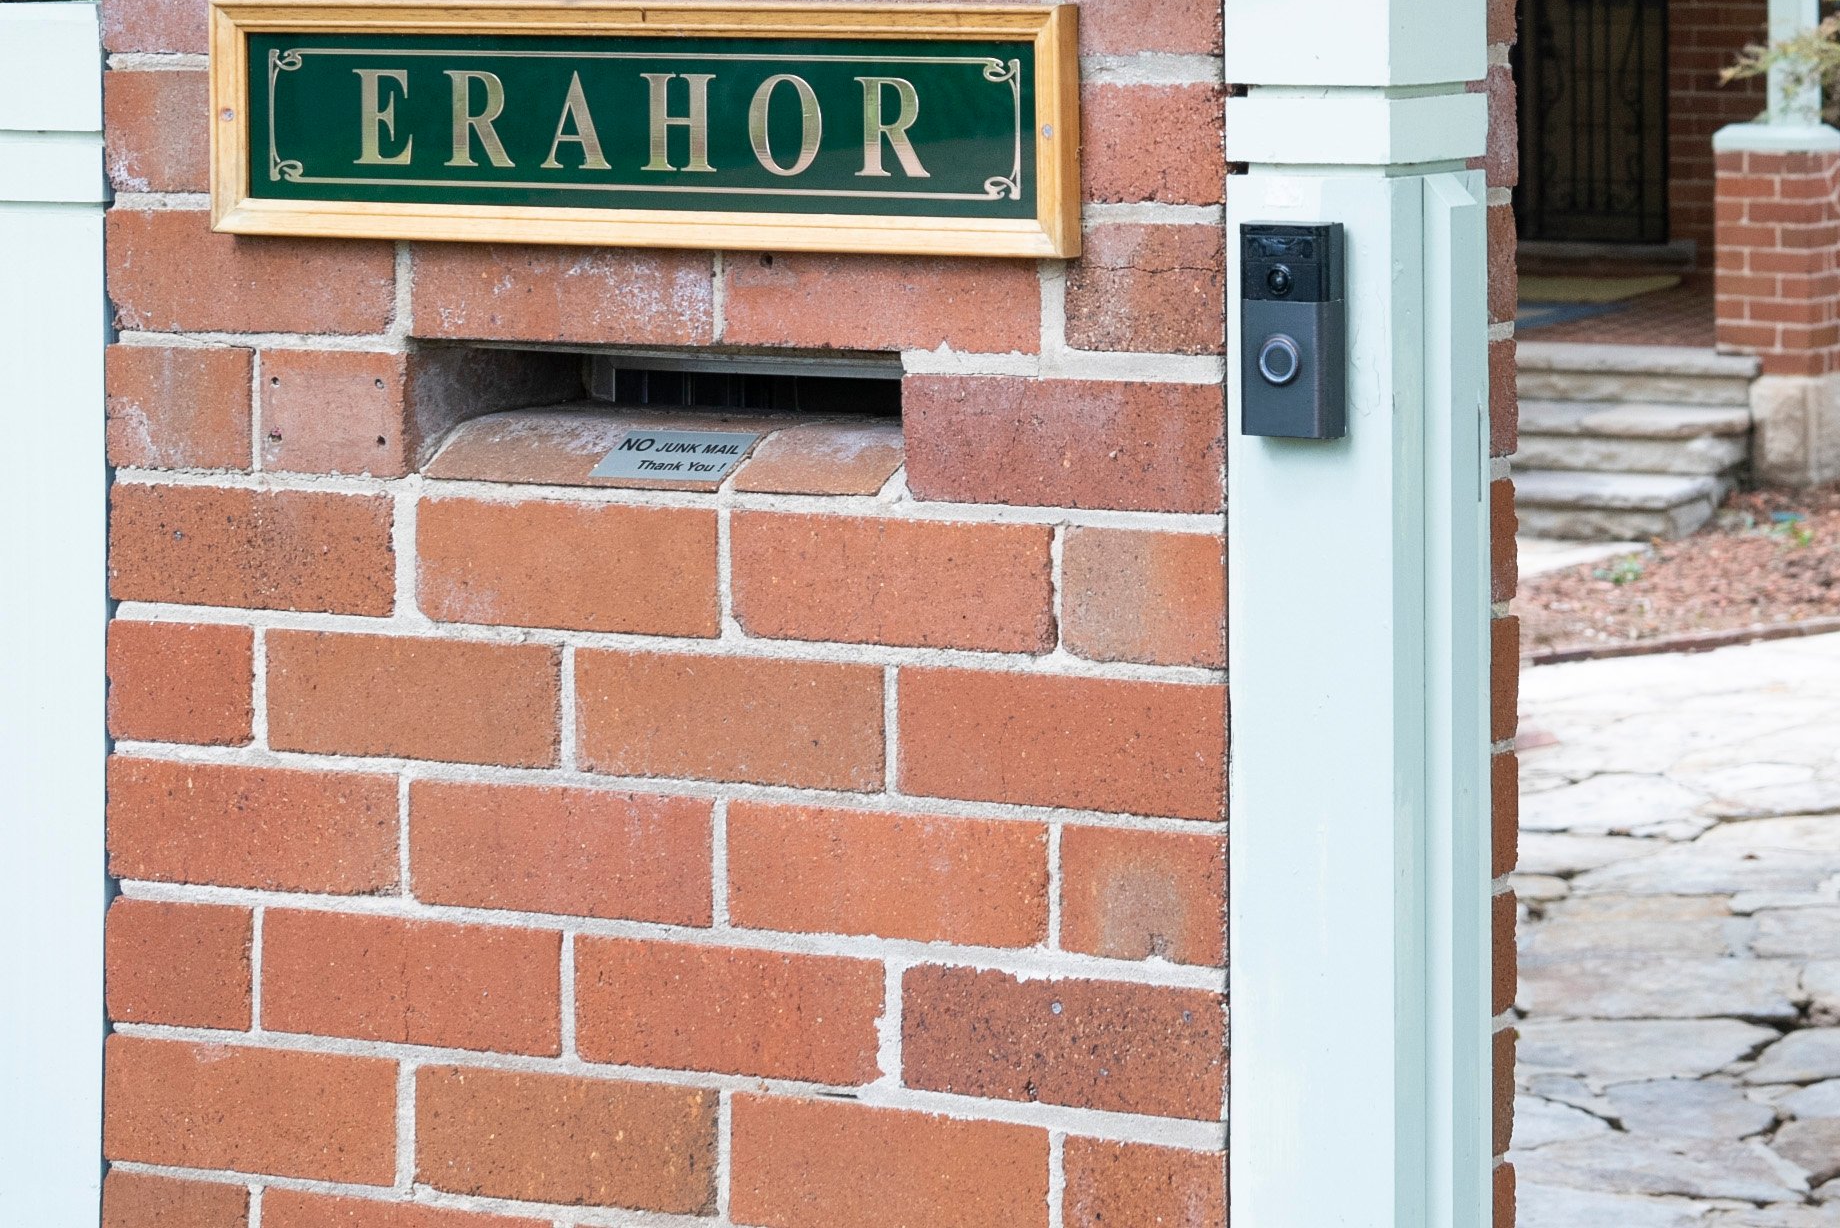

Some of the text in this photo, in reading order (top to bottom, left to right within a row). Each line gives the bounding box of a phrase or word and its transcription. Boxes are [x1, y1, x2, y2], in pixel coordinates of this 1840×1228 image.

[352, 67, 931, 178] ERAHOR
[618, 437, 741, 455] NO JUNK MAIL
[637, 459, 684, 471] Thank
[686, 461, 715, 472] You
